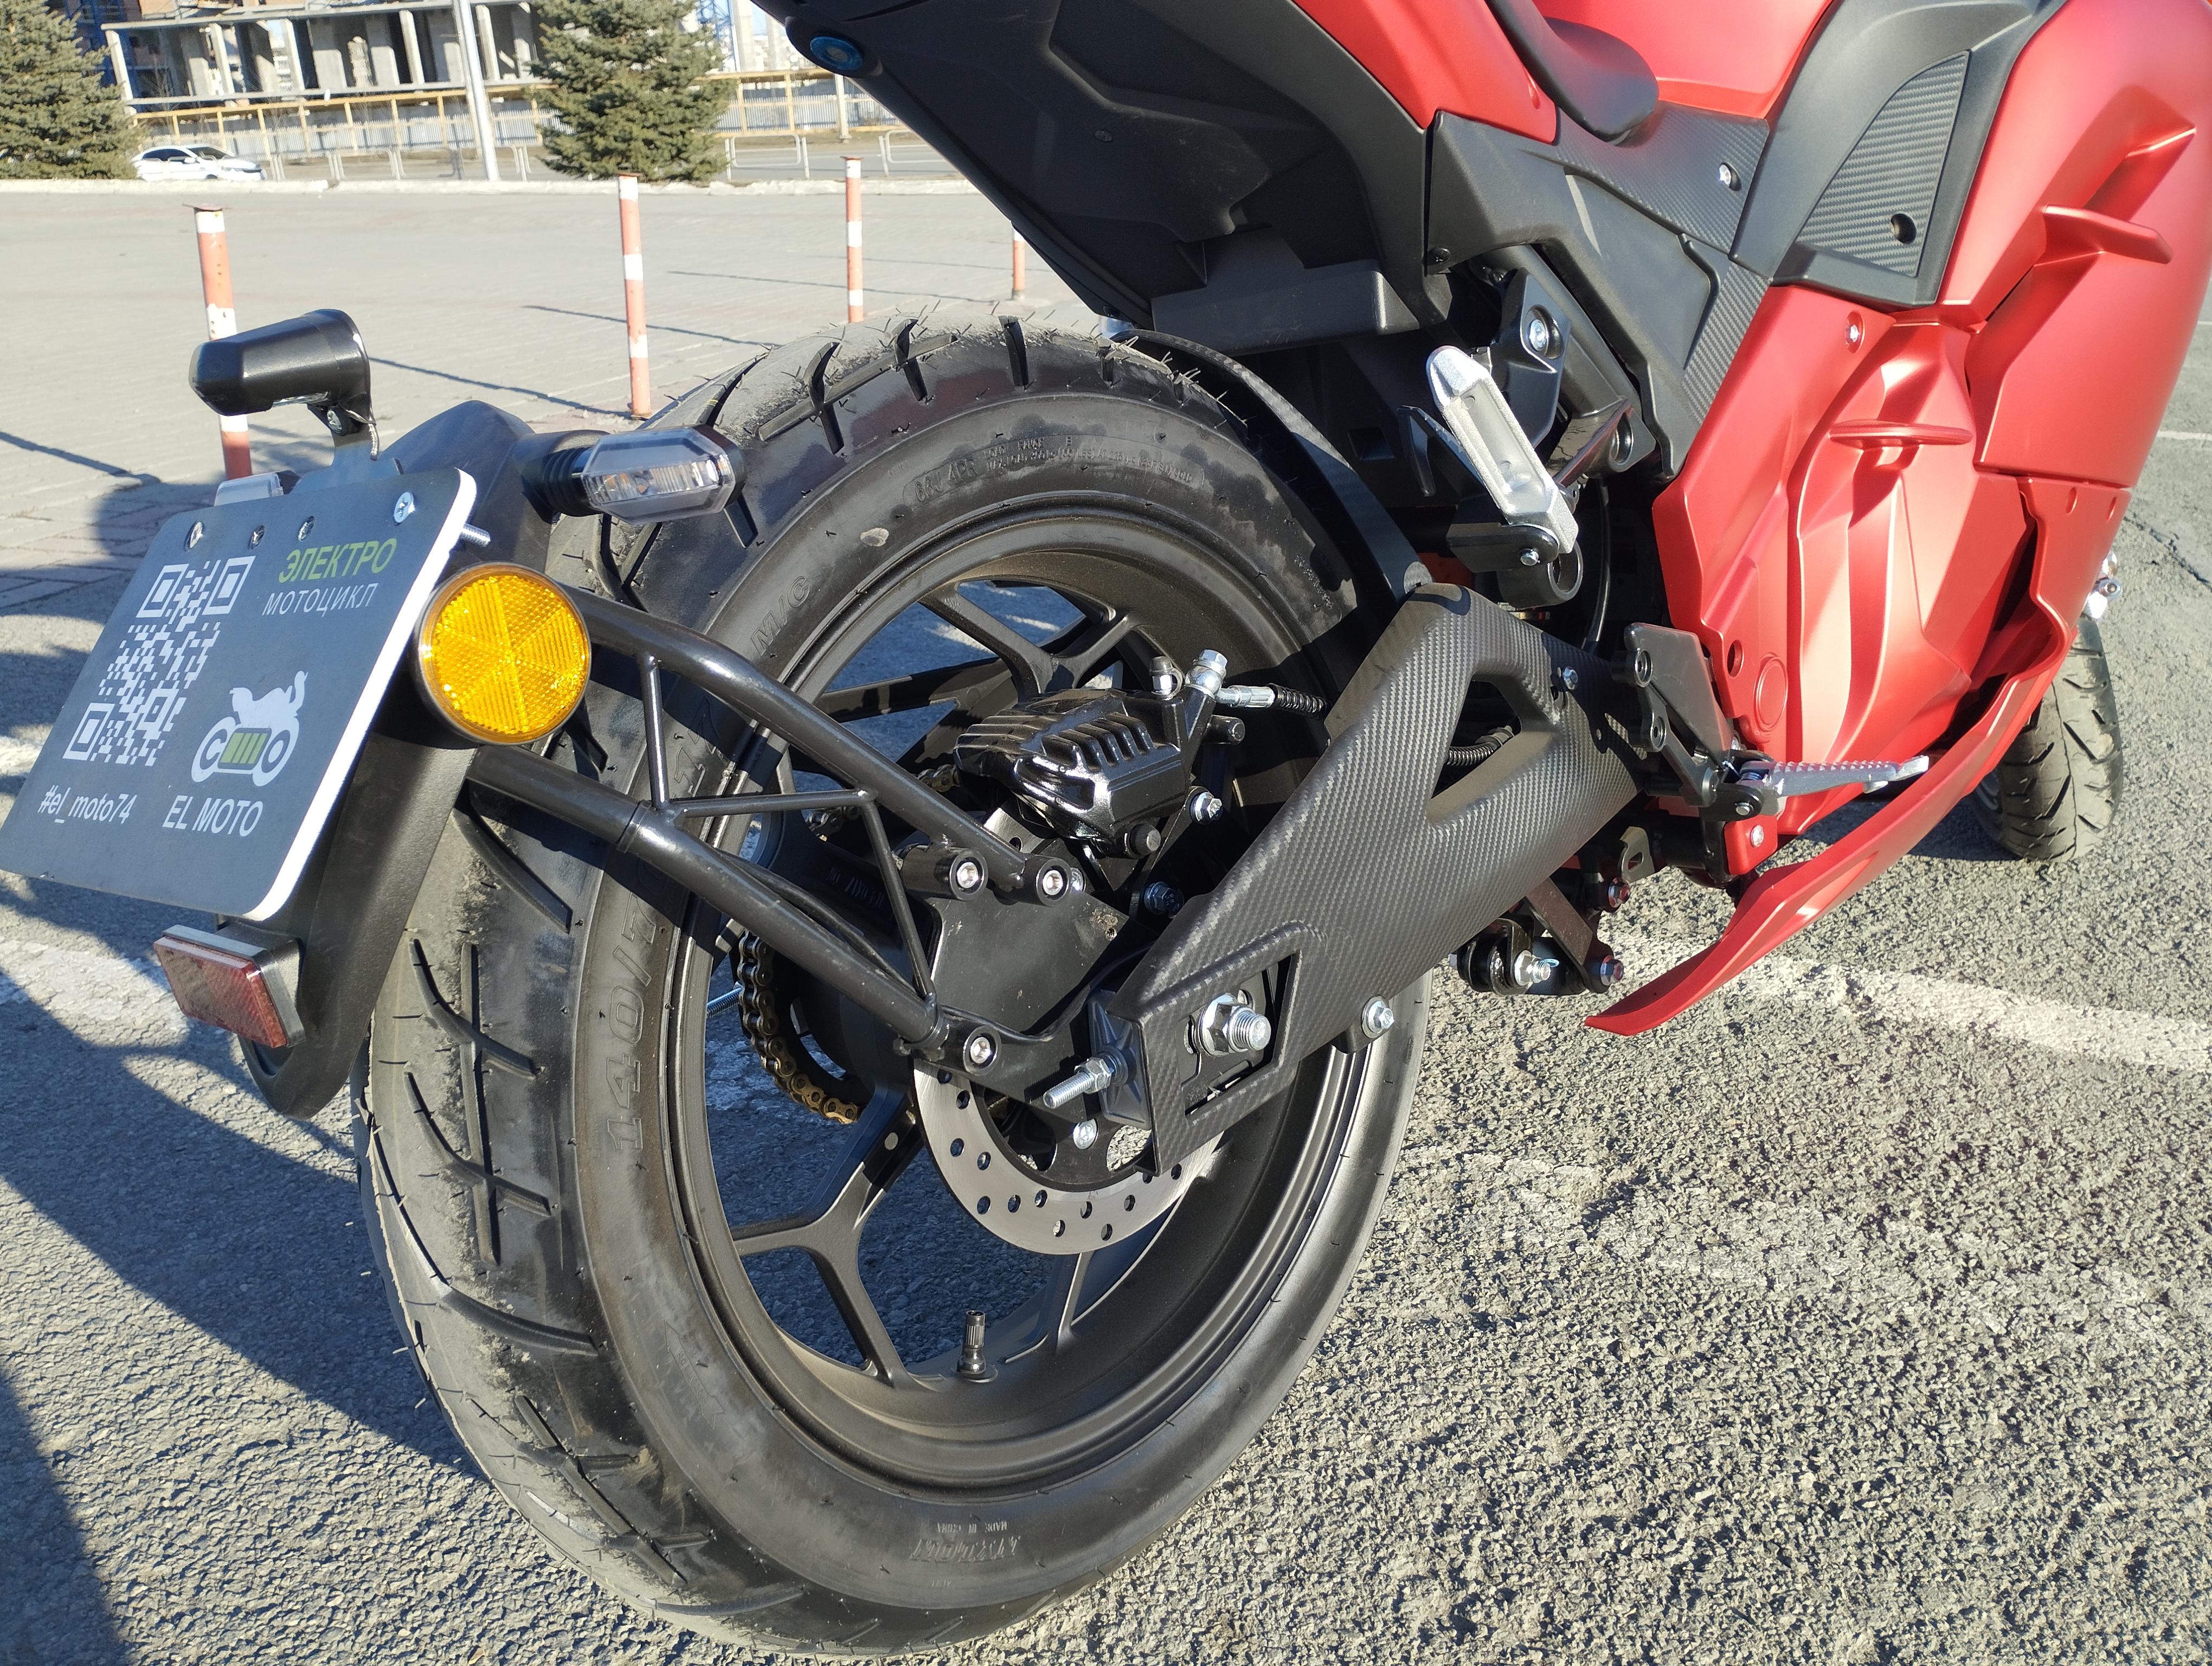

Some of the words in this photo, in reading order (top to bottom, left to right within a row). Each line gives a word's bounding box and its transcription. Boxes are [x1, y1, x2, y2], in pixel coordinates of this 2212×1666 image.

[914, 470, 943, 502] 66J
[279, 538, 397, 584] ЭЛЕКТРО
[262, 582, 379, 618] МОТОЦИКЛ
[750, 575, 810, 657] M/C
[37, 785, 138, 824] #el_moto74
[162, 795, 194, 830] EL
[192, 797, 264, 837] MOTO
[968, 1522, 977, 1534] IN
